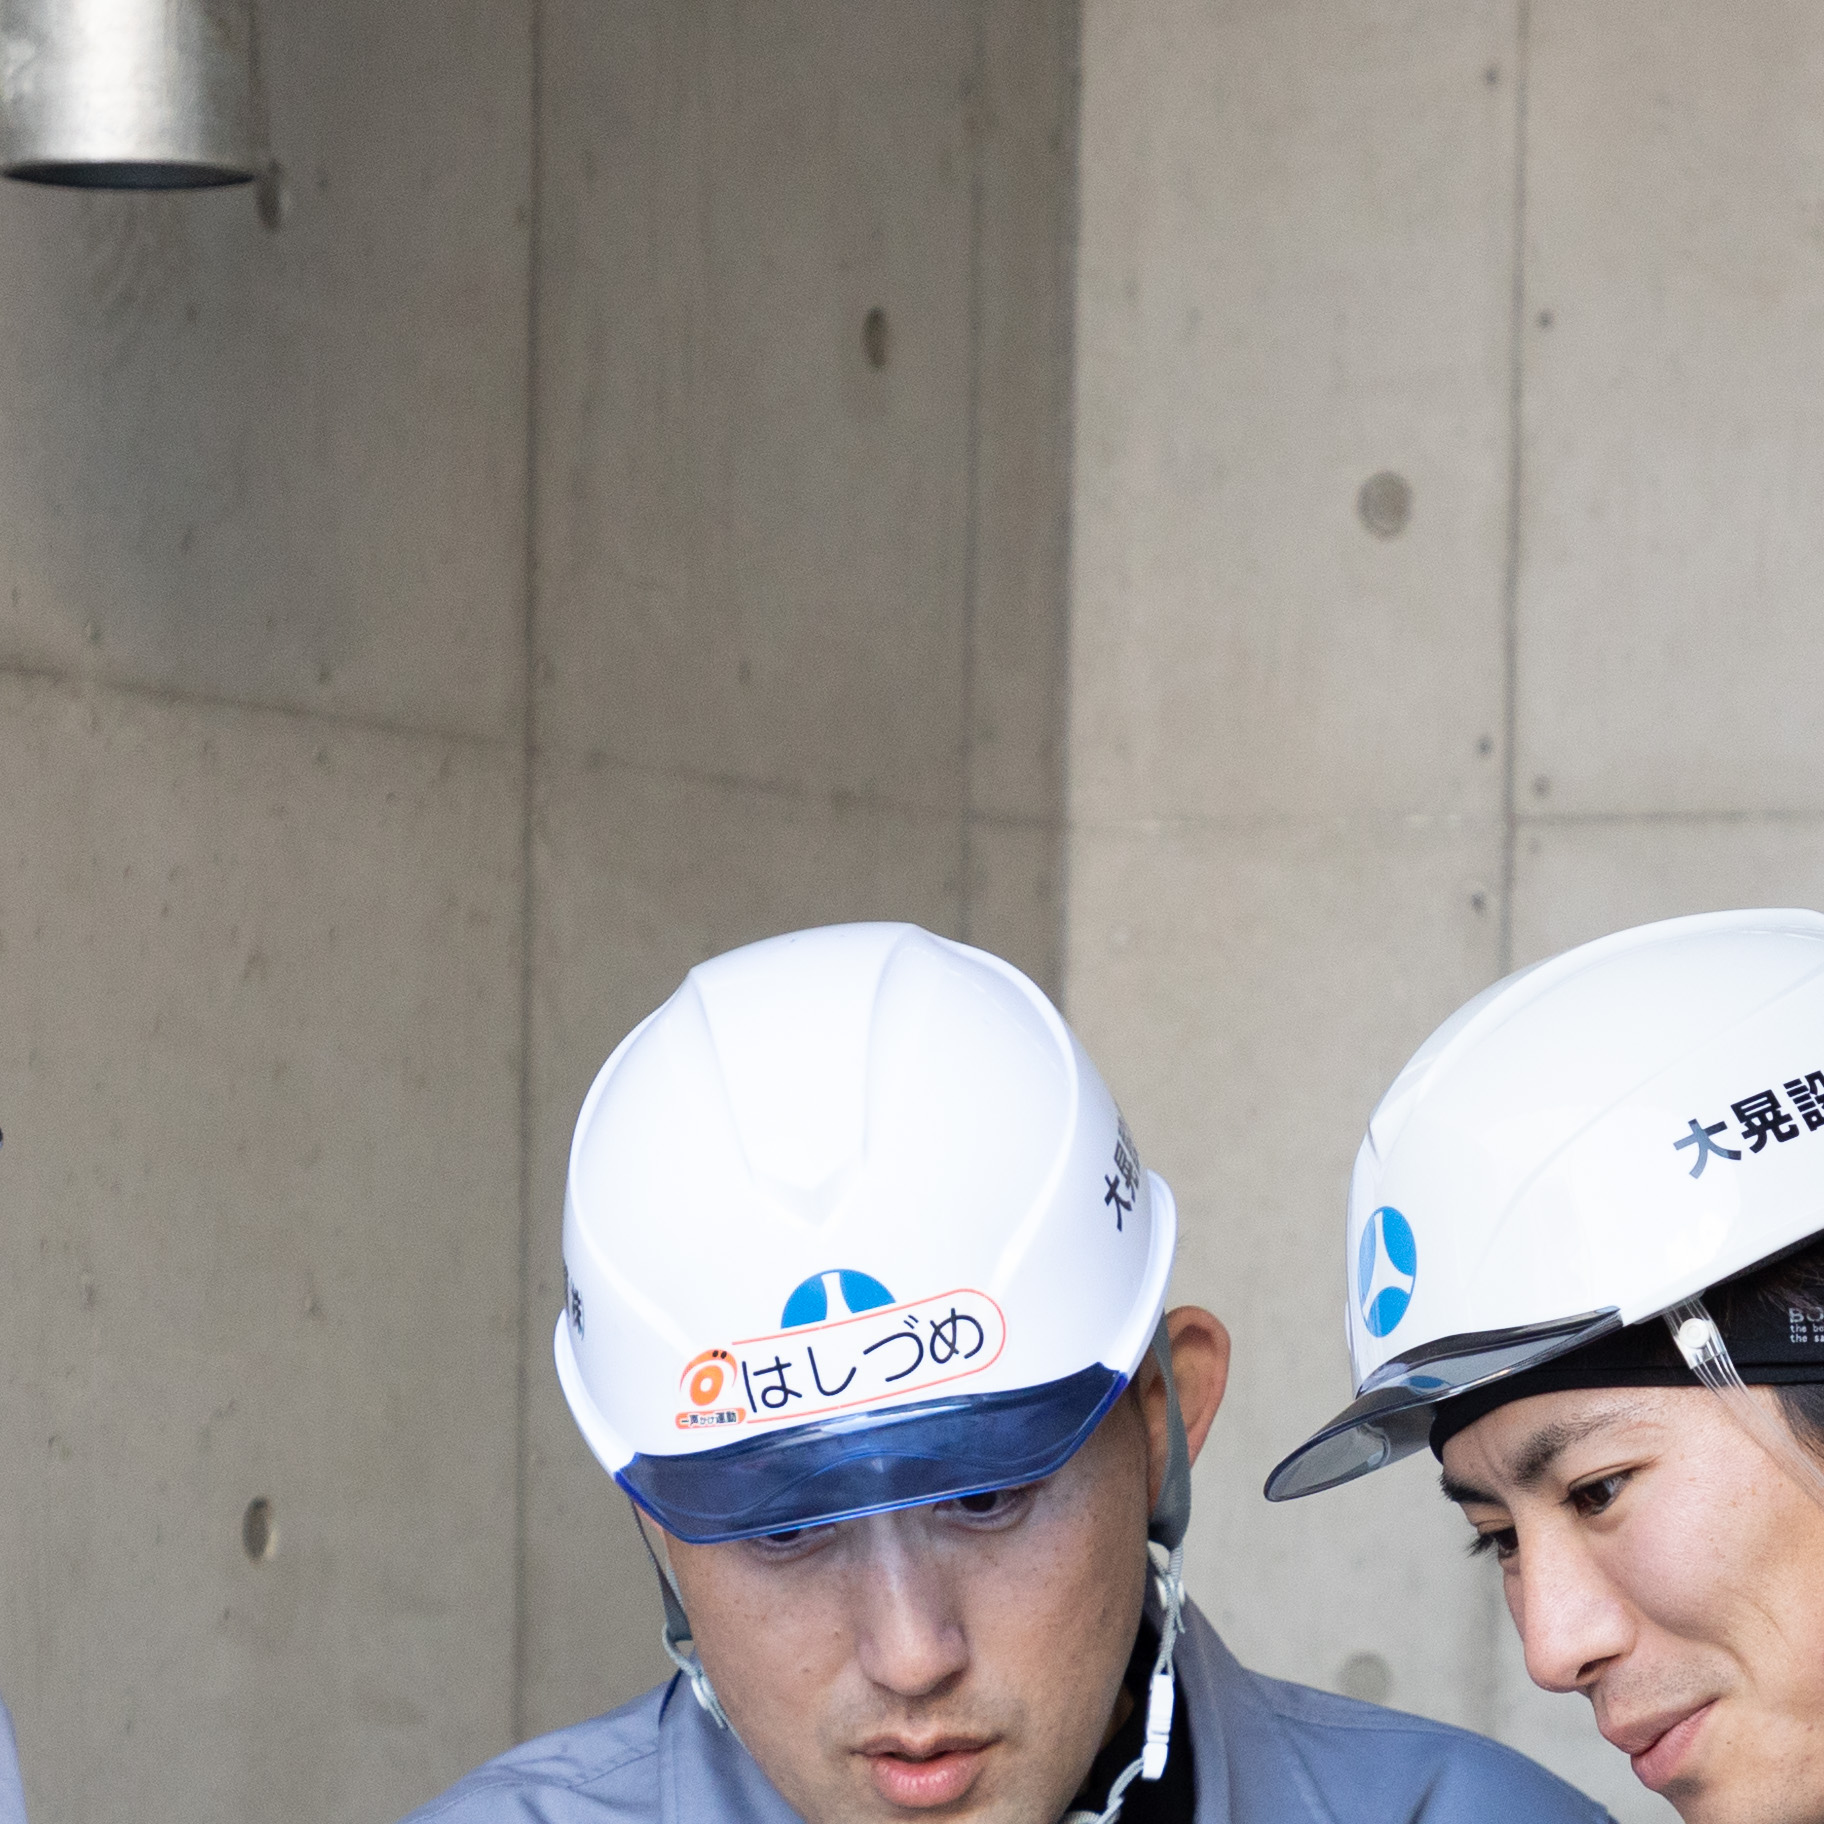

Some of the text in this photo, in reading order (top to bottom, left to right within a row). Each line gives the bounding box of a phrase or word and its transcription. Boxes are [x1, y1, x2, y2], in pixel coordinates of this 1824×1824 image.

[1790, 1323, 1808, 1333] the
[1790, 1333, 1808, 1343] the
[742, 1308, 984, 1413] はしづめ
